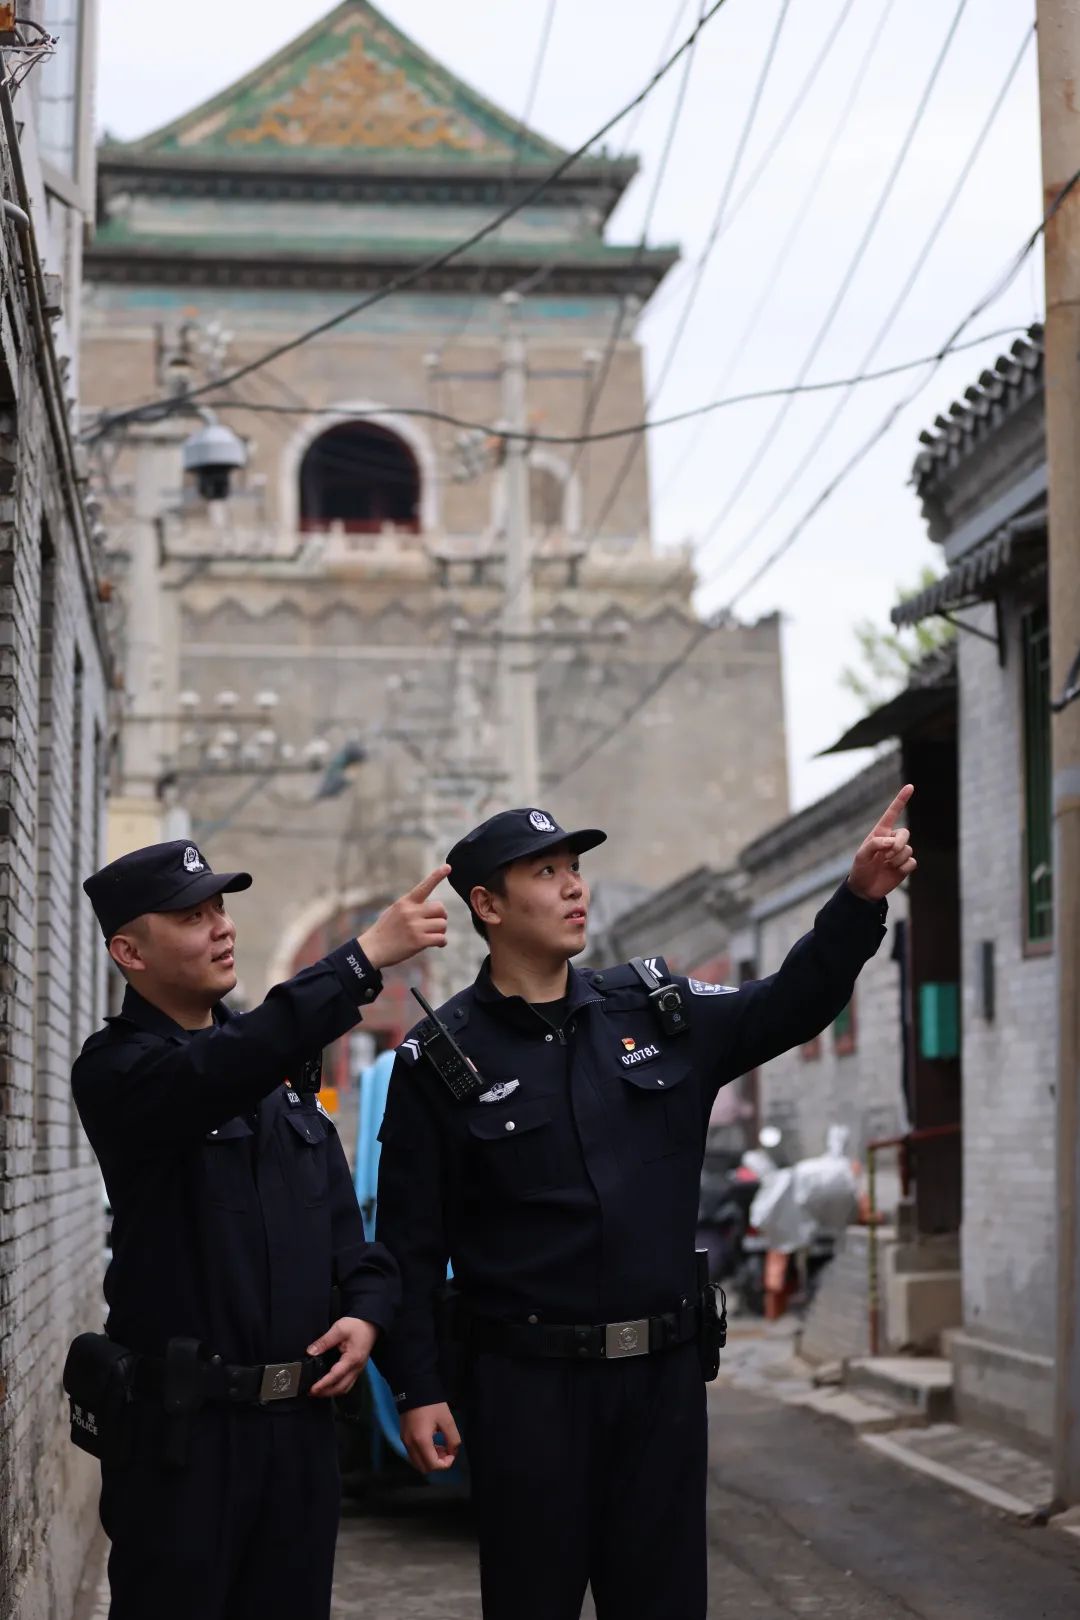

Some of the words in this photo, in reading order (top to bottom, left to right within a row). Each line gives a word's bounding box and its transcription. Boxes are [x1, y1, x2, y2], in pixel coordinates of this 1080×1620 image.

[346, 954, 366, 979] POLICE
[621, 1044, 660, 1065] 020781
[72, 1413, 99, 1436] POLICE
